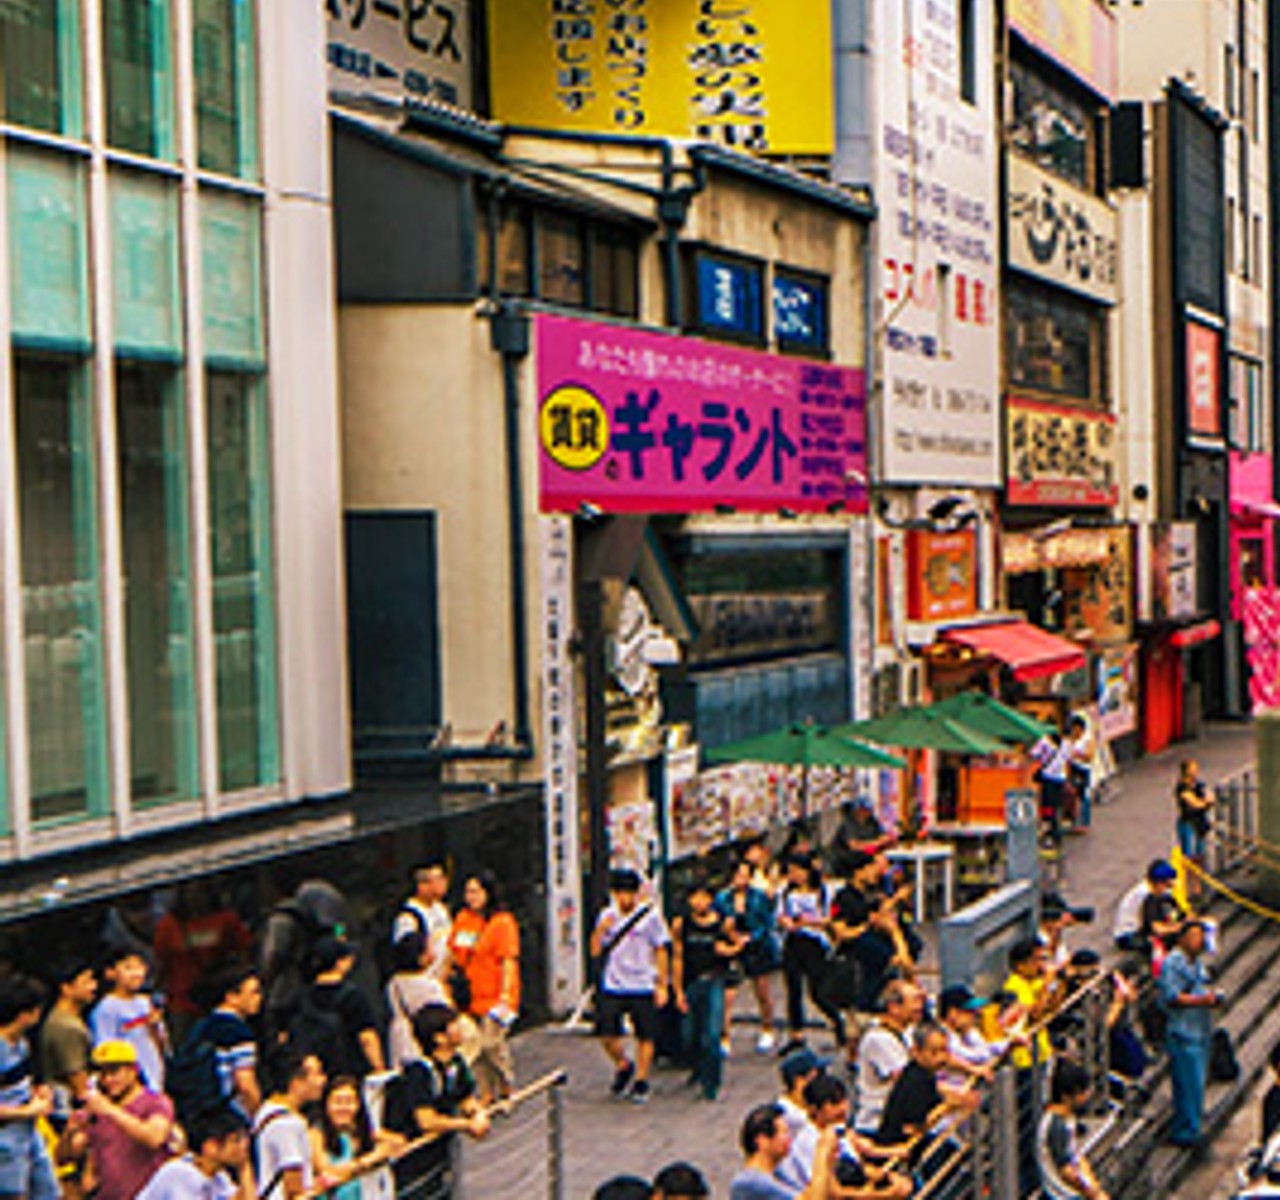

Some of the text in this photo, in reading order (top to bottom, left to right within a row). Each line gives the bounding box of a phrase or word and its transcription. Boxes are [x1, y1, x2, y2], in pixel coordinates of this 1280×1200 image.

[611, 388, 798, 484] ギャラント
